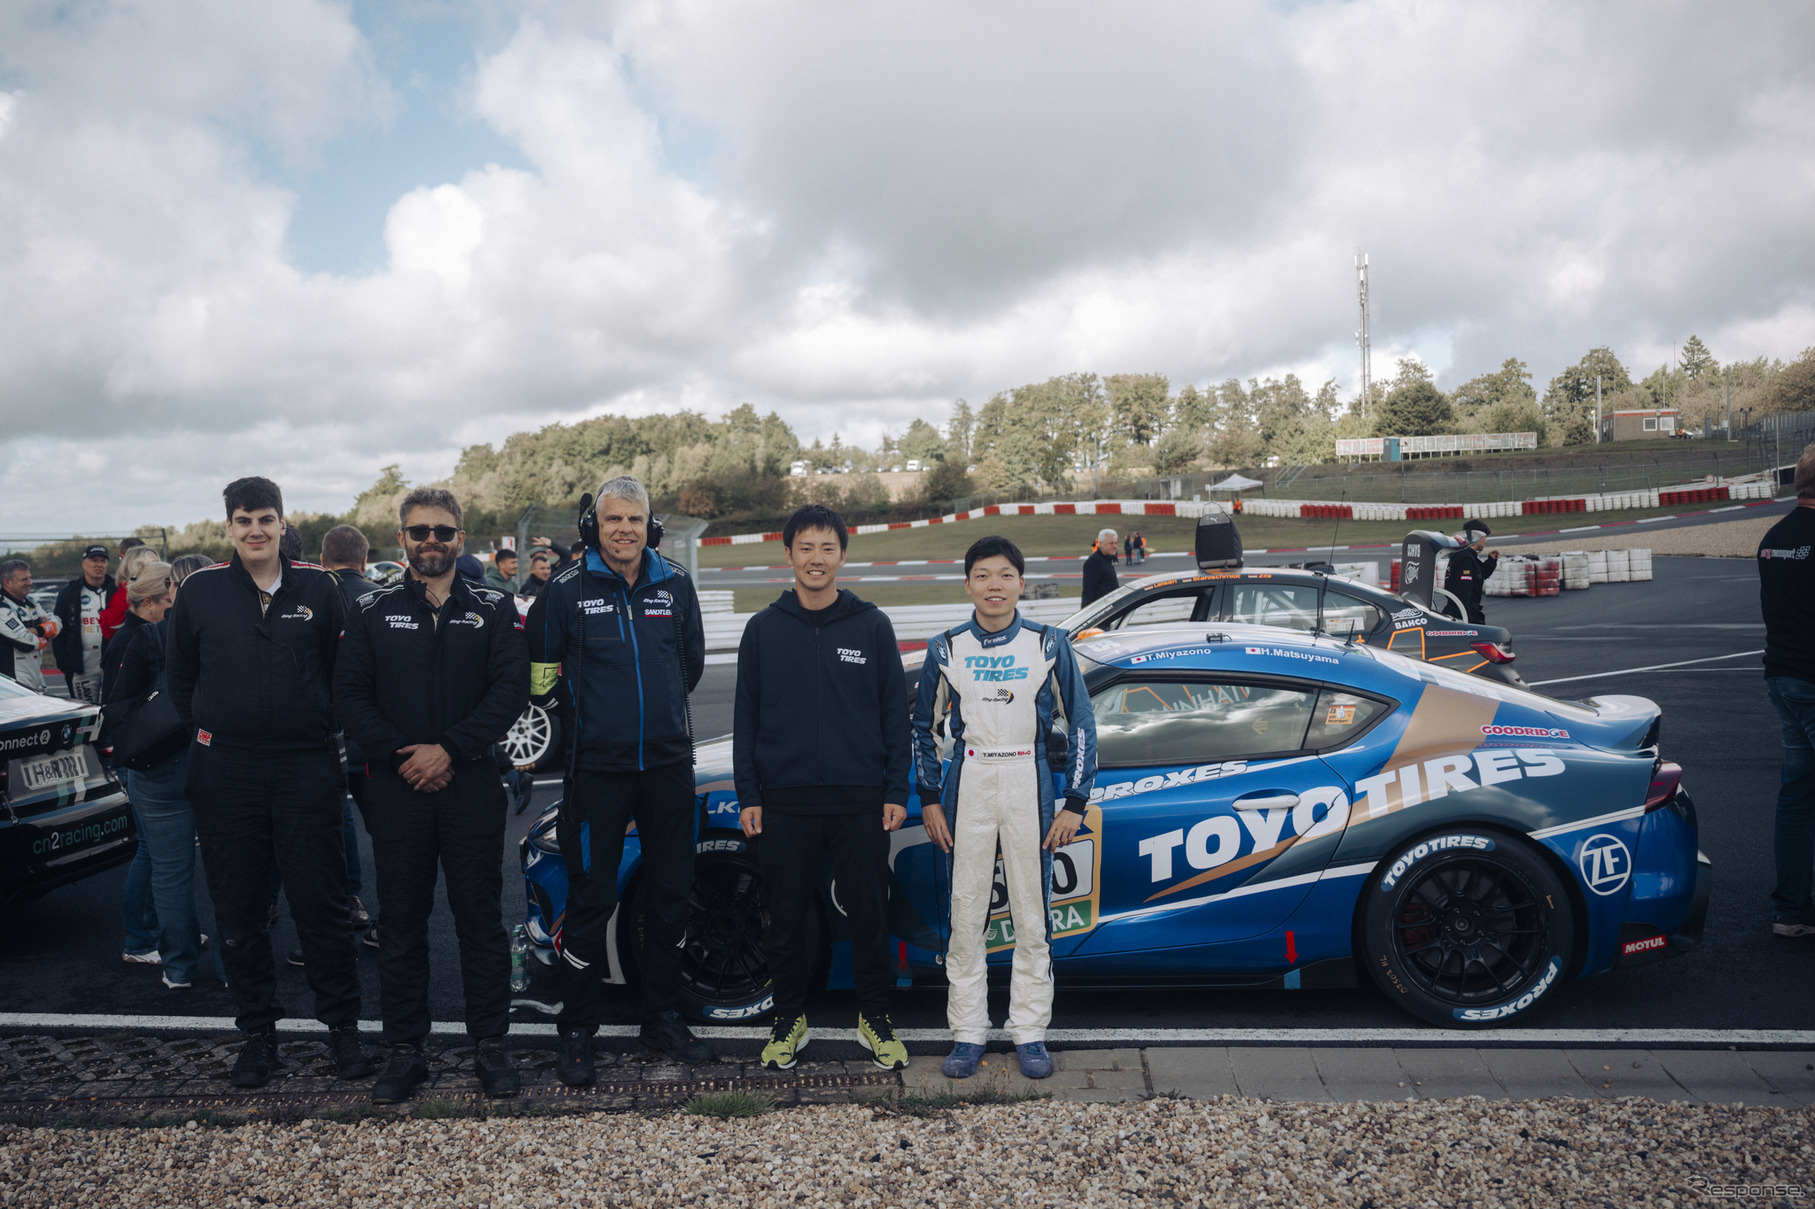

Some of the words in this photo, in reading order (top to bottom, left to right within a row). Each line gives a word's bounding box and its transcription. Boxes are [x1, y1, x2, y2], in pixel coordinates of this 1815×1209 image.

[577, 599, 605, 608] TOYO
[584, 605, 614, 615] TIRES
[390, 622, 420, 630] TIRES
[1394, 618, 1428, 630] BAHCO
[837, 648, 862, 657] TOYO
[840, 655, 867, 664] TIRES
[1146, 647, 1211, 661] T.Miyazono
[1261, 647, 1339, 665] H.Matsuyama
[964, 655, 1015, 669] TOYO
[973, 667, 1029, 682] TIRES
[1480, 725, 1571, 739] GOODRIDGE
[1089, 760, 1248, 800] PROXES
[1138, 786, 1351, 883] TOYO
[1355, 748, 1566, 819] TIRES
[33, 815, 128, 854] cn2racing.com
[696, 840, 740, 854] IRES
[1384, 845, 1428, 888] TOYO
[1428, 835, 1490, 852] TIRES
[1582, 842, 1630, 888] ZF
[1624, 936, 1665, 954] MOTUL
[1460, 961, 1559, 1022] PROXES
[709, 996, 774, 1018] OXES
